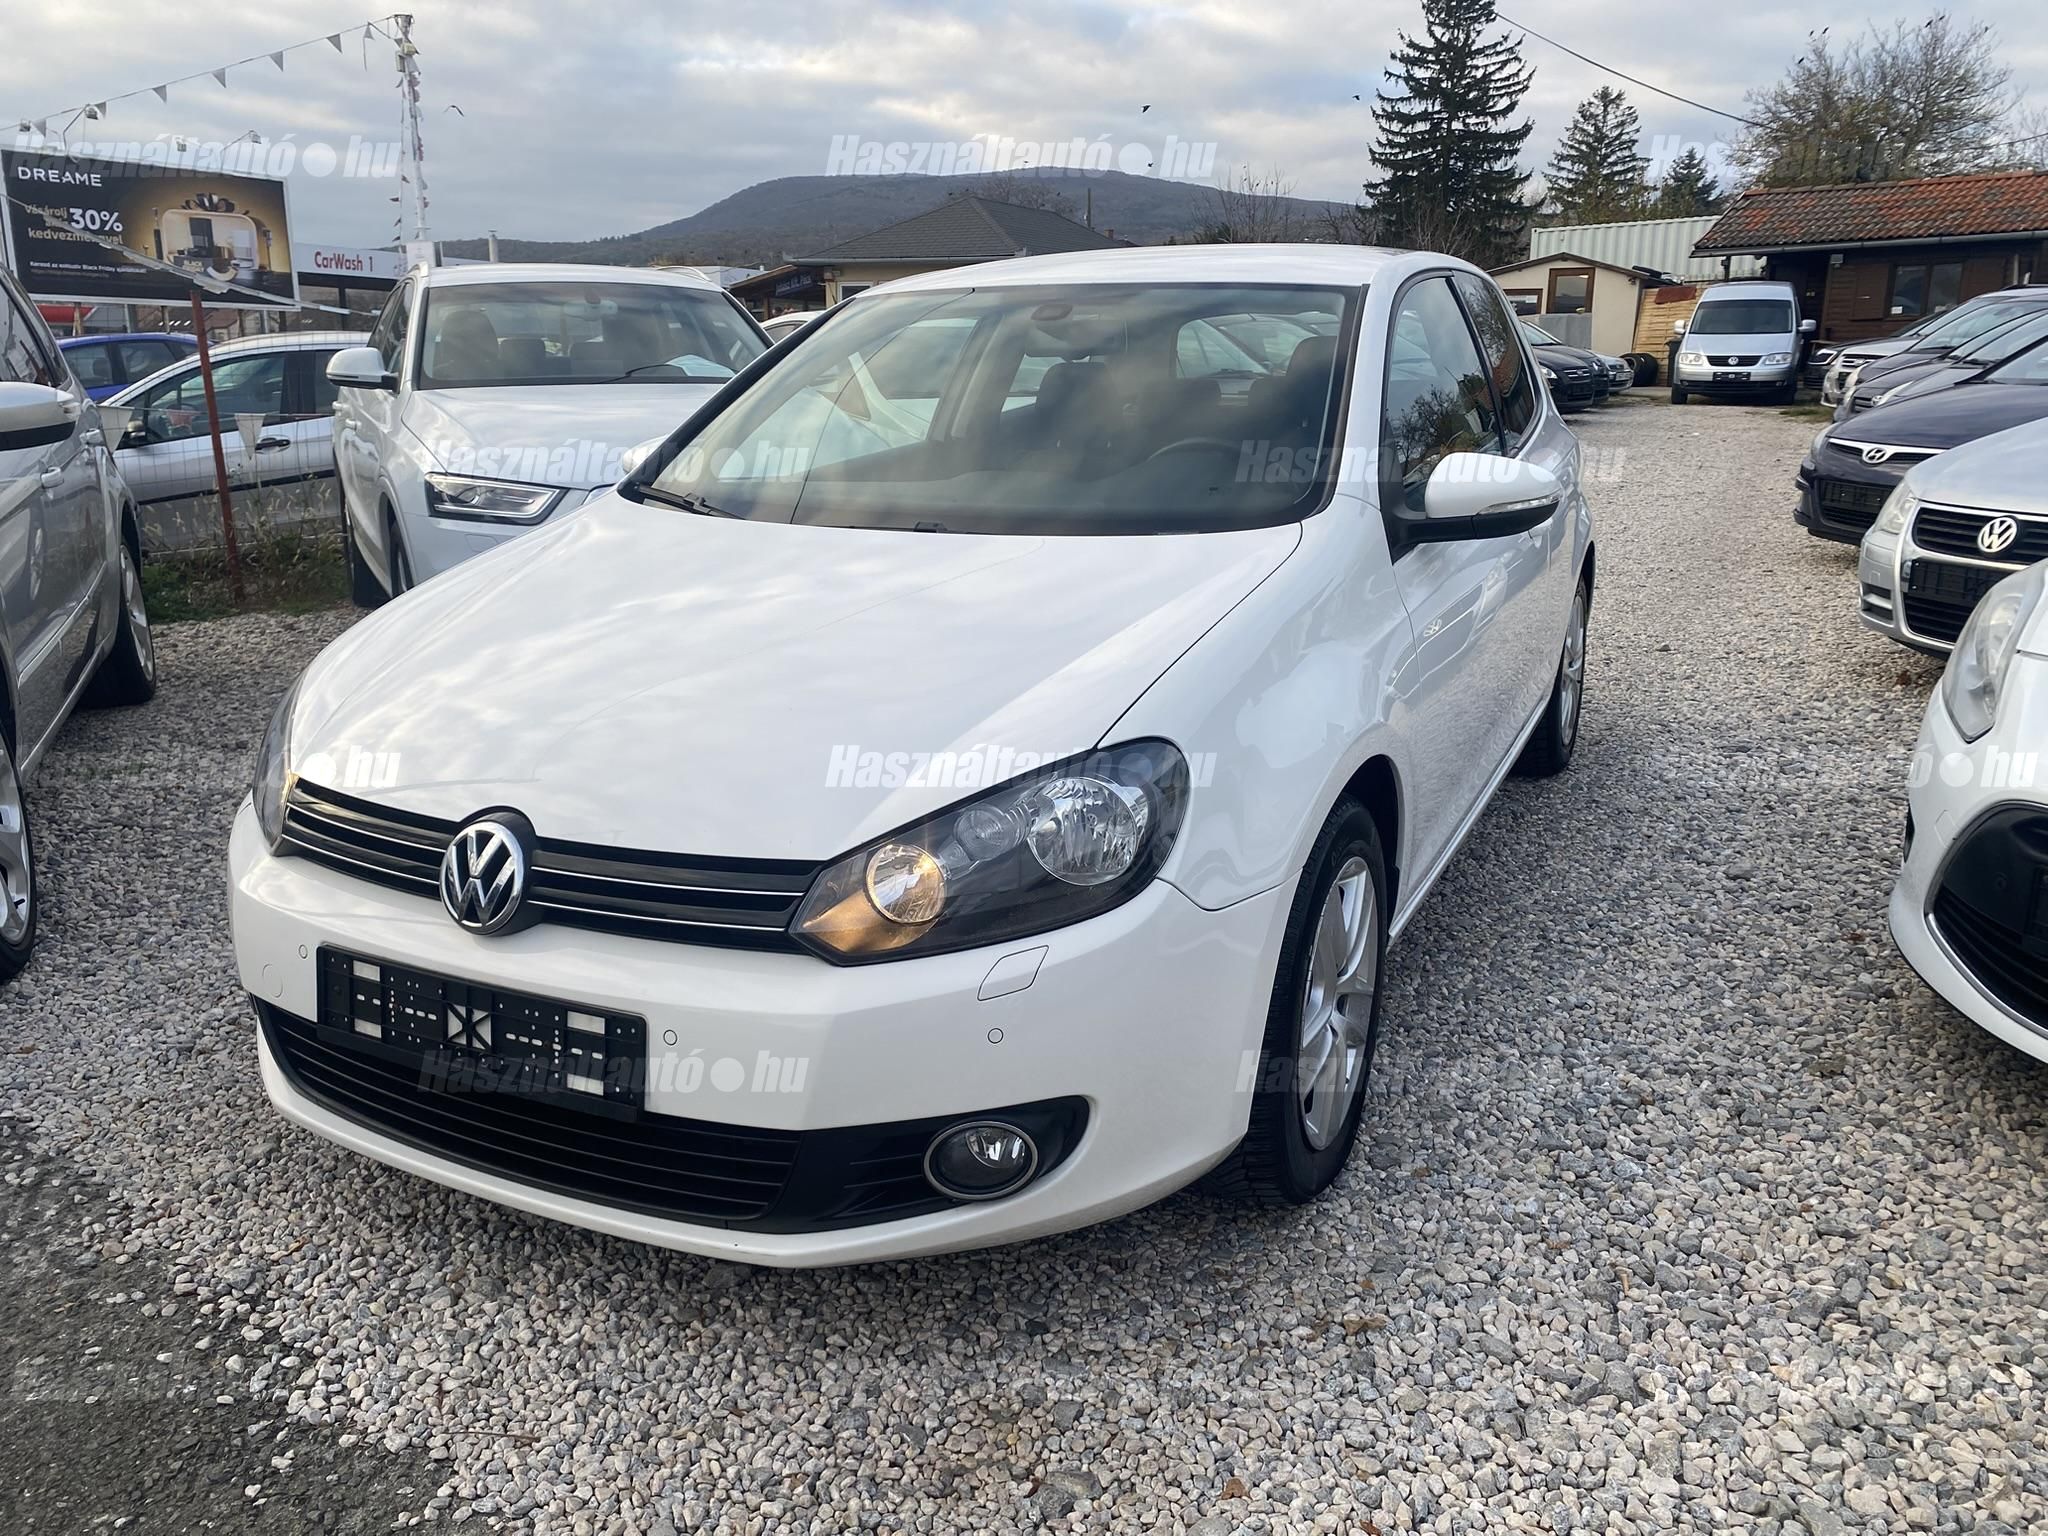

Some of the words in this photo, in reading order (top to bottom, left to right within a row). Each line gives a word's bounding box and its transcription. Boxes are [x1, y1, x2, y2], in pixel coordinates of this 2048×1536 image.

[17, 166, 102, 187] DREAME
[69, 207, 123, 232] 30%
[314, 251, 363, 272] CarWash
[442, 824, 521, 932] VW
